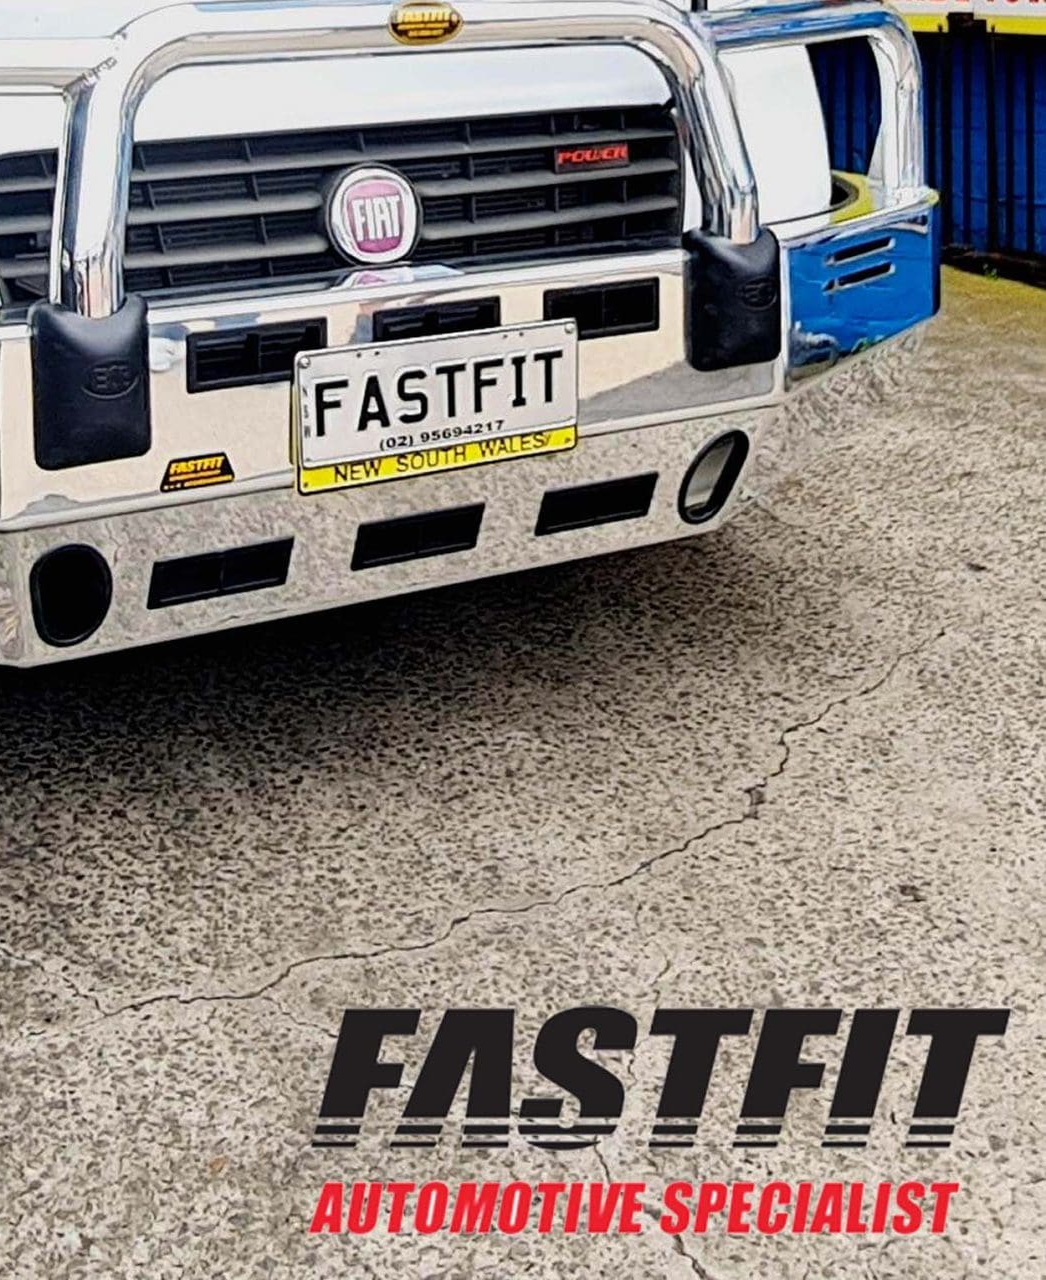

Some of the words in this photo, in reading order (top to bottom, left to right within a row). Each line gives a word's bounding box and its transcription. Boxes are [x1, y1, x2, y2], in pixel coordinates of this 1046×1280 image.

[557, 142, 628, 165] POWER
[351, 194, 401, 243] FIAT
[315, 349, 564, 438] FASTFIT
[379, 435, 415, 452] (02)
[420, 419, 505, 443] 95694217
[333, 461, 383, 484] NEW
[396, 447, 467, 473] SOUTH
